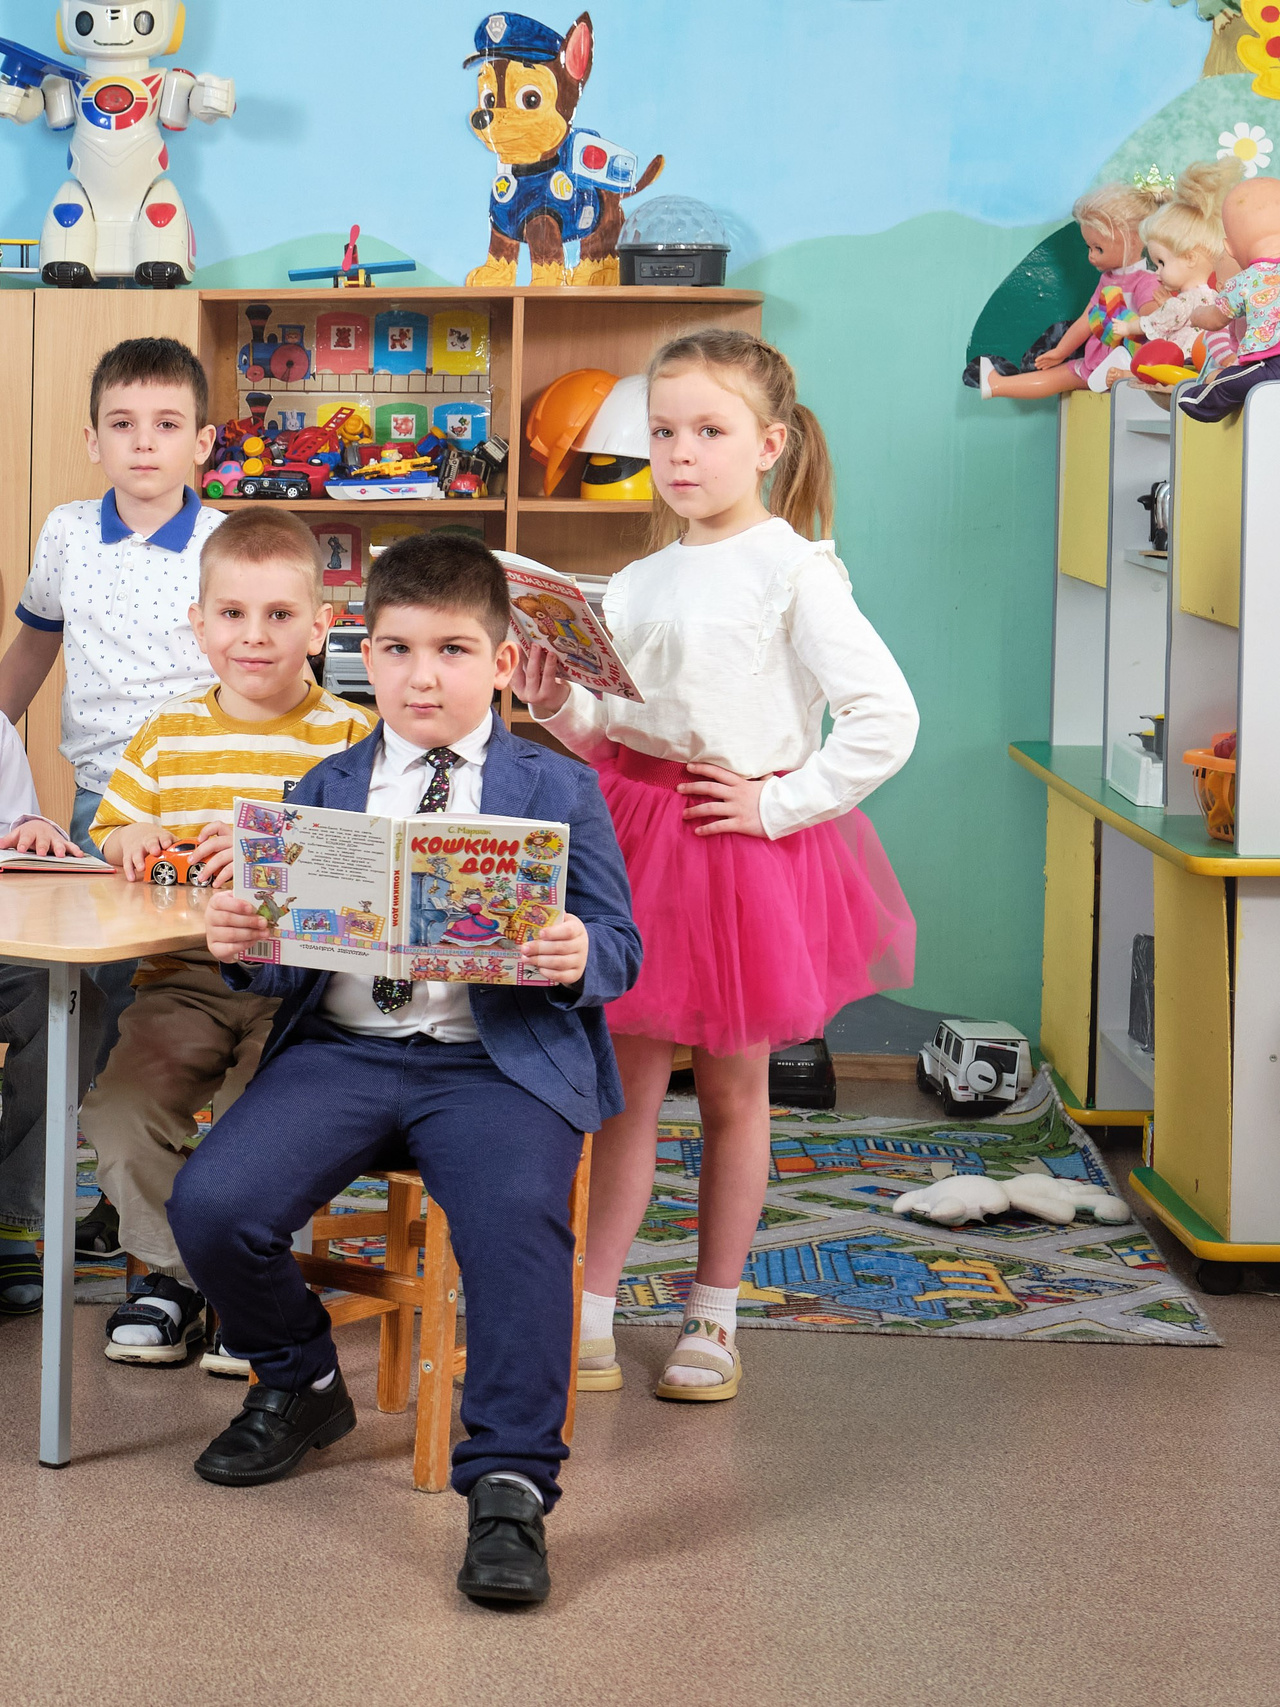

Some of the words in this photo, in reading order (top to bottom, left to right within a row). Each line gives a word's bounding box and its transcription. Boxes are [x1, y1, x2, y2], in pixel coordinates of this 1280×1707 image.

[457, 827, 492, 837] Маршак
[411, 836, 521, 857] КОШКИН
[458, 856, 520, 875] ДОМ
[393, 869, 401, 906] КОШКИН
[392, 907, 400, 927] ДОМ
[683, 1319, 728, 1347] OVE
